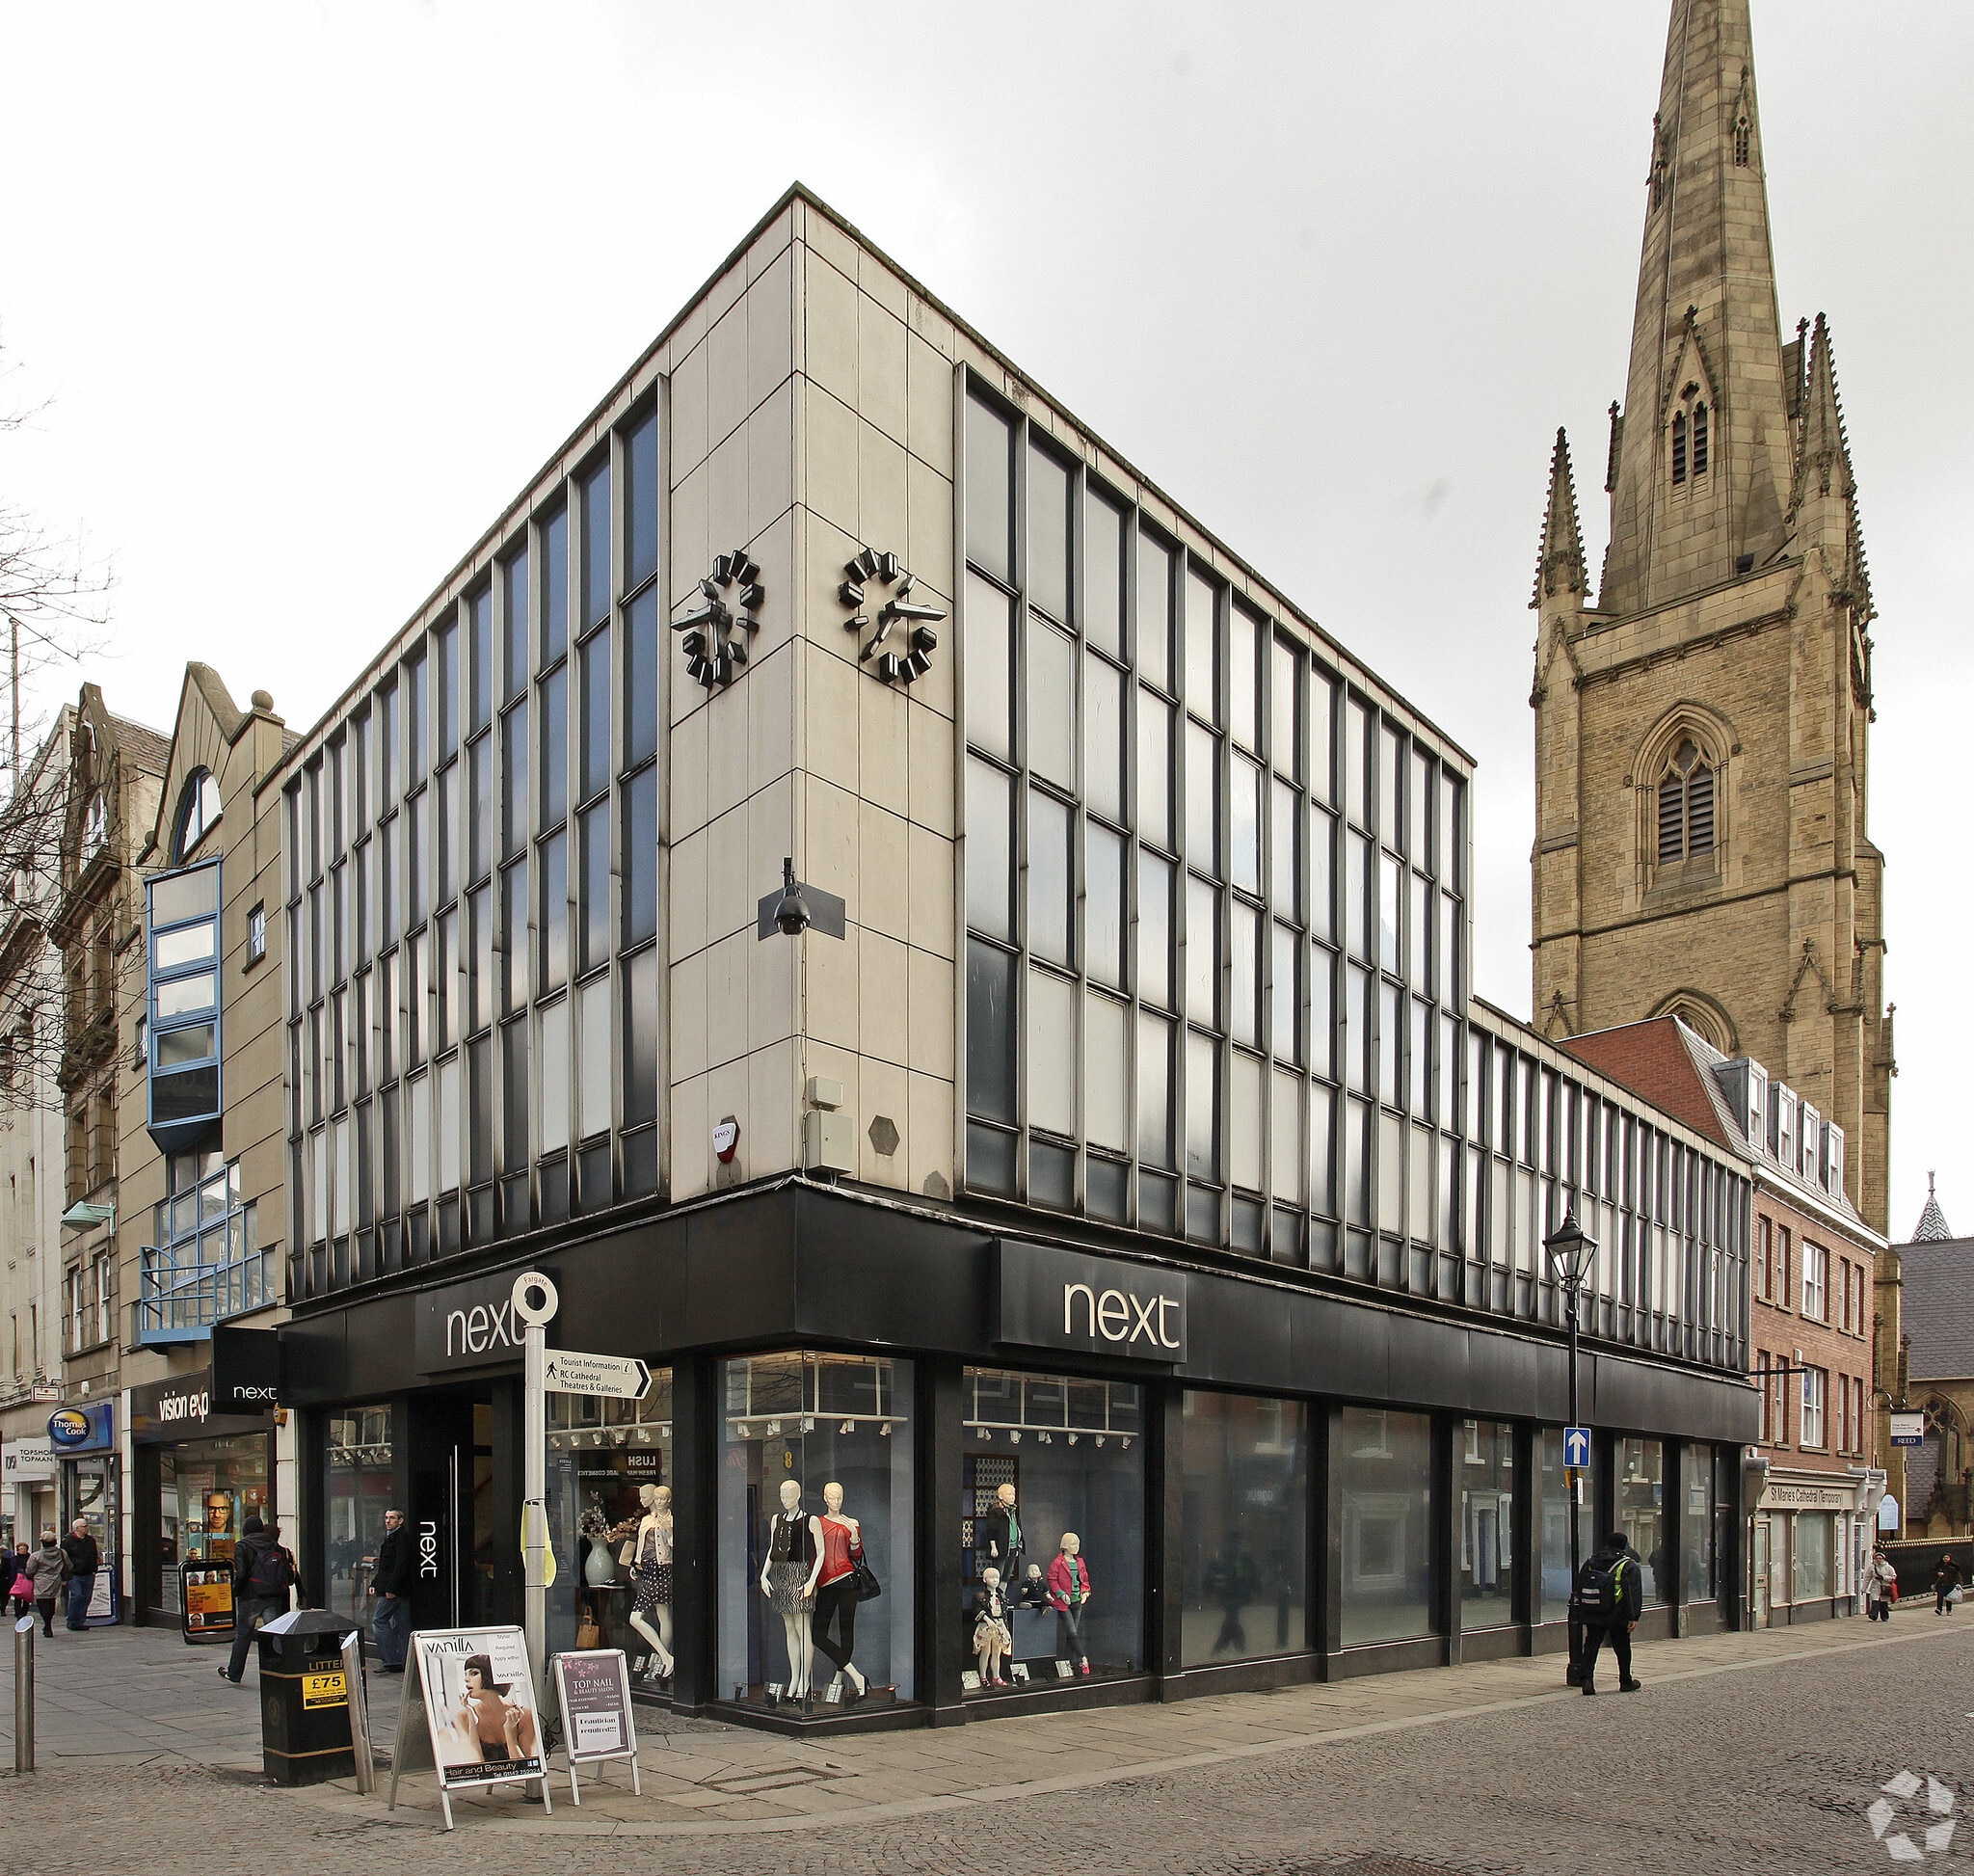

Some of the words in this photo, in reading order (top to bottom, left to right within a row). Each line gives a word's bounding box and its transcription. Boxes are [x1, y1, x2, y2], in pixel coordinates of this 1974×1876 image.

[714, 1130, 731, 1139] KINGS
[523, 1276, 547, 1286] Fargate
[1064, 1283, 1181, 1349] next
[560, 1356, 582, 1367] Tourist
[584, 1359, 620, 1370] Information
[560, 1369, 569, 1378] RC
[571, 1371, 601, 1381] Cathedral
[233, 1386, 277, 1400] next
[560, 1380, 588, 1390] Theatres
[596, 1383, 623, 1394] Galleries
[159, 1390, 187, 1421] vision
[53, 1420, 86, 1428] Thomas
[1771, 1487, 1777, 1501] St
[1796, 1488, 1818, 1502] Cathedral
[1819, 1490, 1843, 1506] (Temporary)
[420, 1521, 438, 1579] next
[312, 1676, 341, 1689] £75
[573, 1680, 591, 1689] TOP
[593, 1678, 614, 1687] NAIL
[465, 1766, 483, 1774] and
[485, 1762, 517, 1772] Beauty
